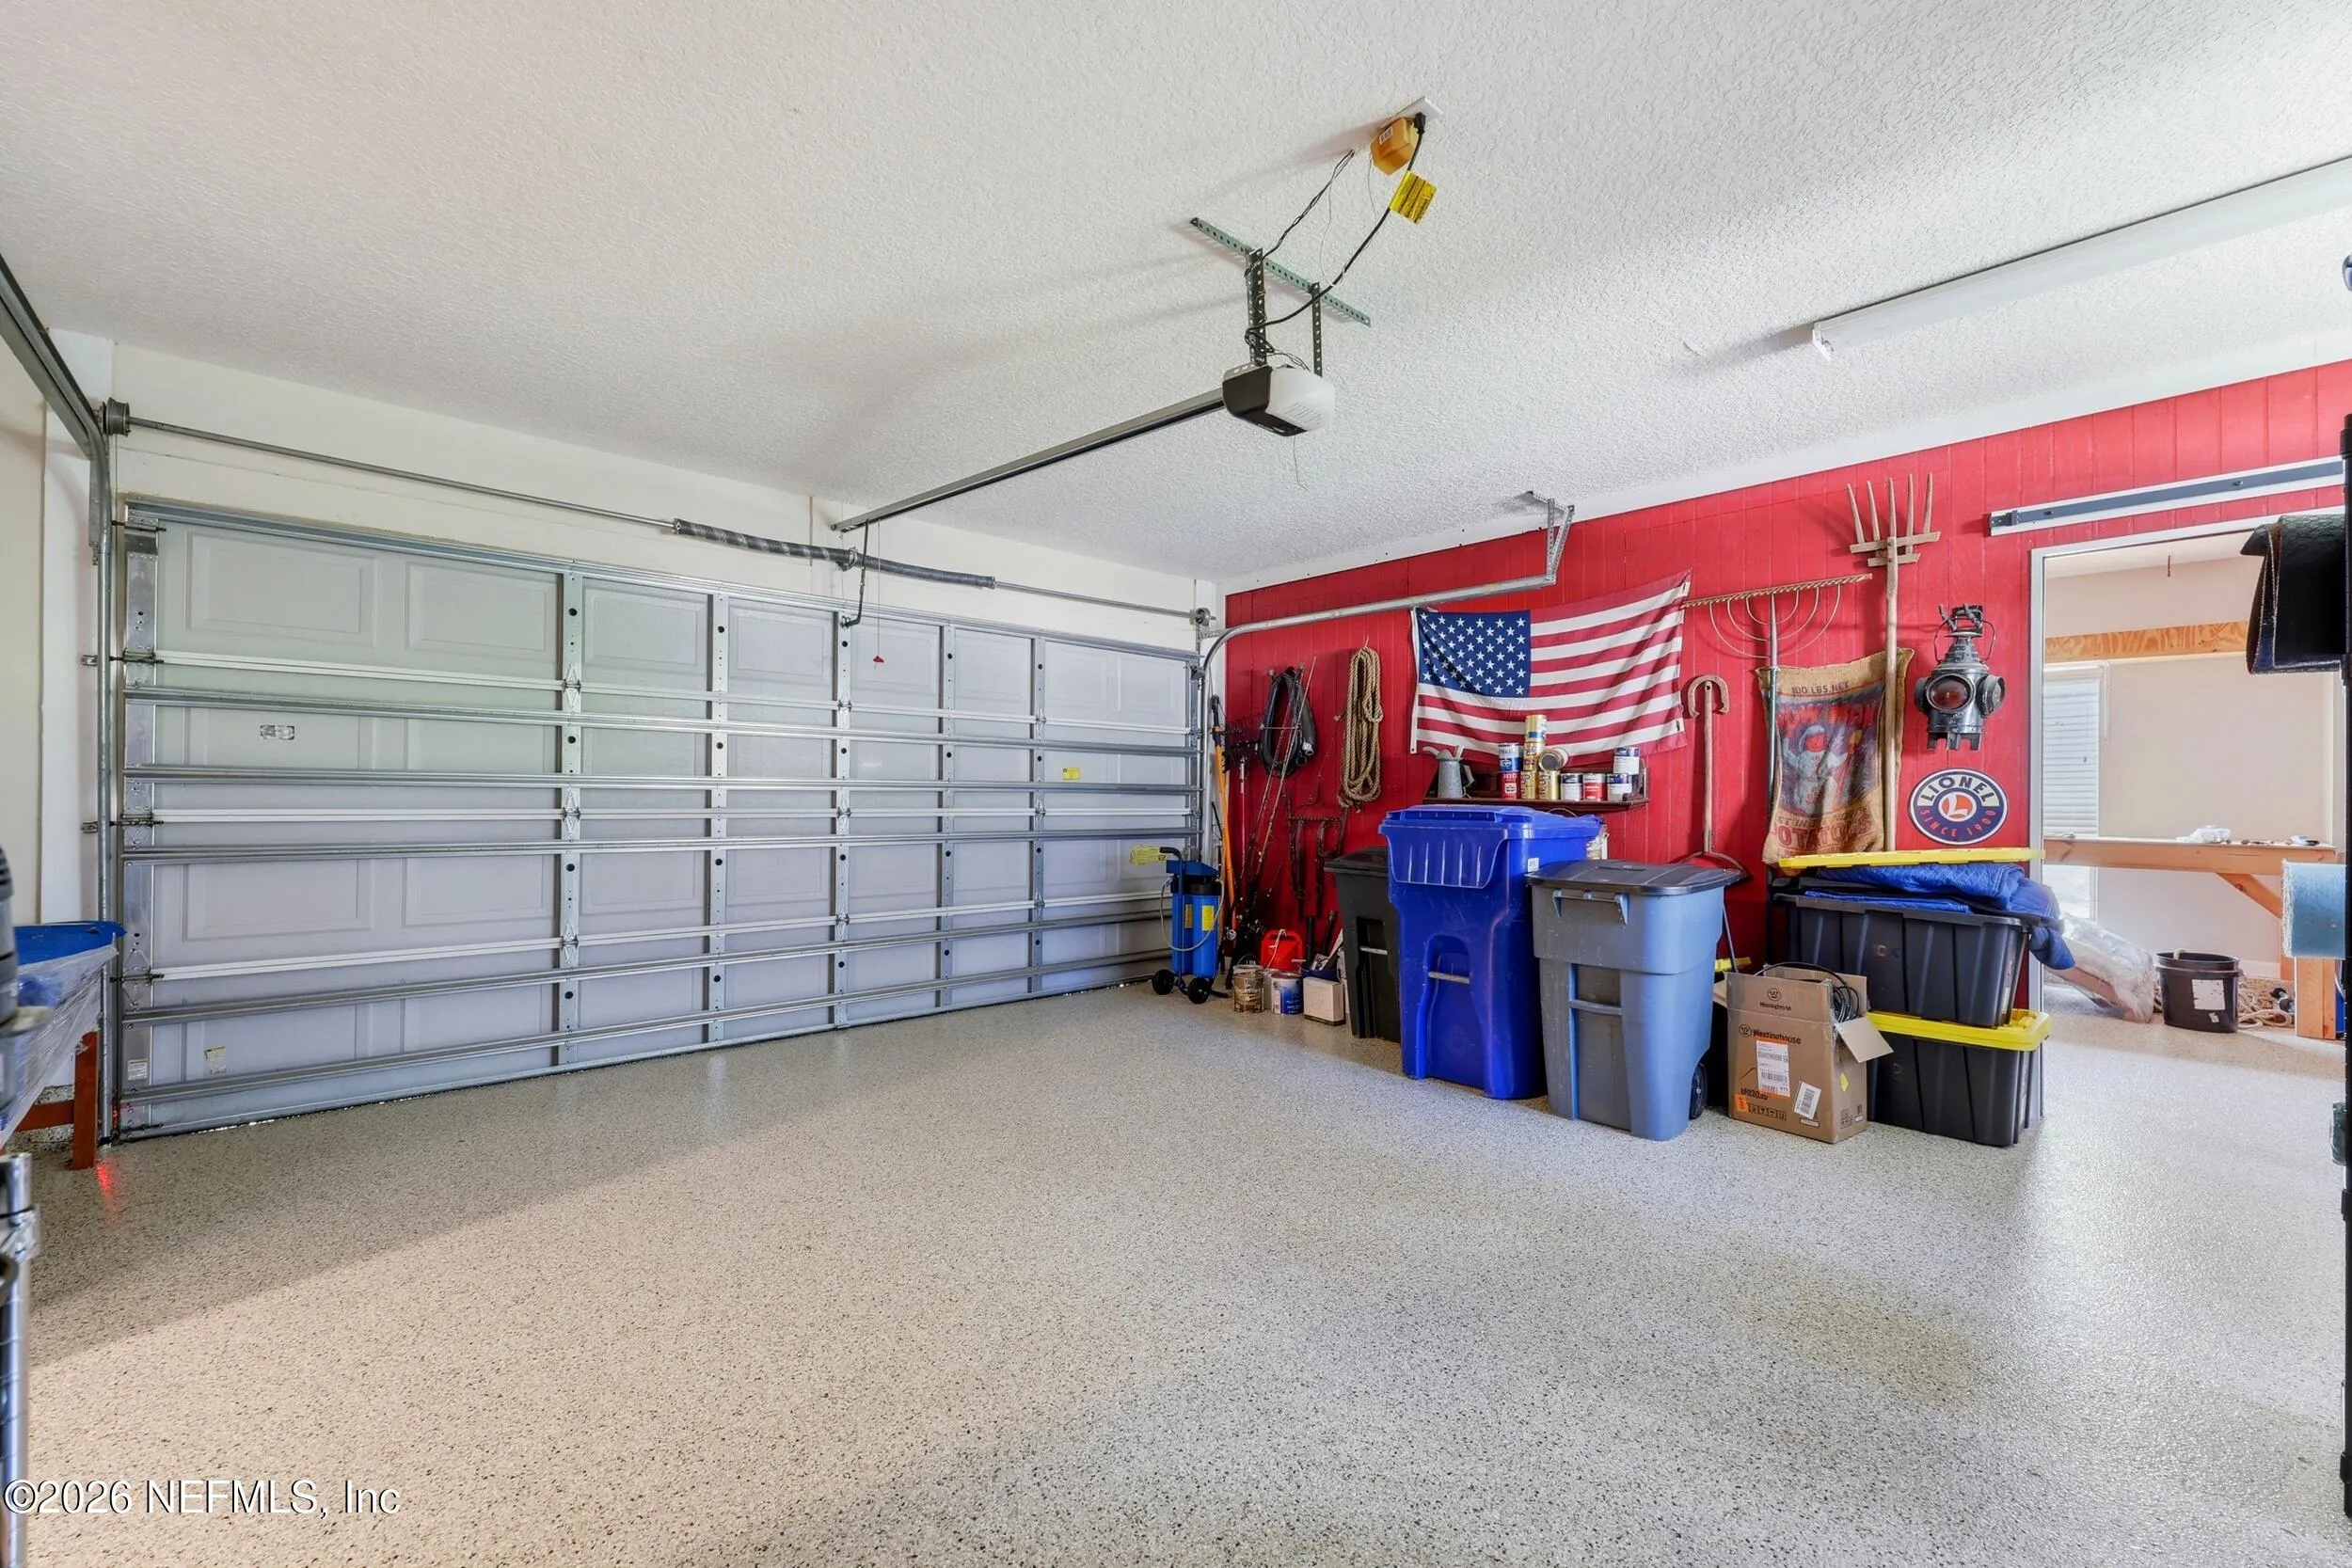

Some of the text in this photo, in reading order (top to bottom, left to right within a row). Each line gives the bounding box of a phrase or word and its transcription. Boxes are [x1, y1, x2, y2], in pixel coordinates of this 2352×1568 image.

[1791, 685, 1808, 694] 100
[1920, 776, 1994, 802] LIONEL
[1773, 815, 1872, 848] OTATOES
[1919, 809, 1996, 837] SINCE 1900
[1753, 1028, 1802, 1044] Westinghouse
